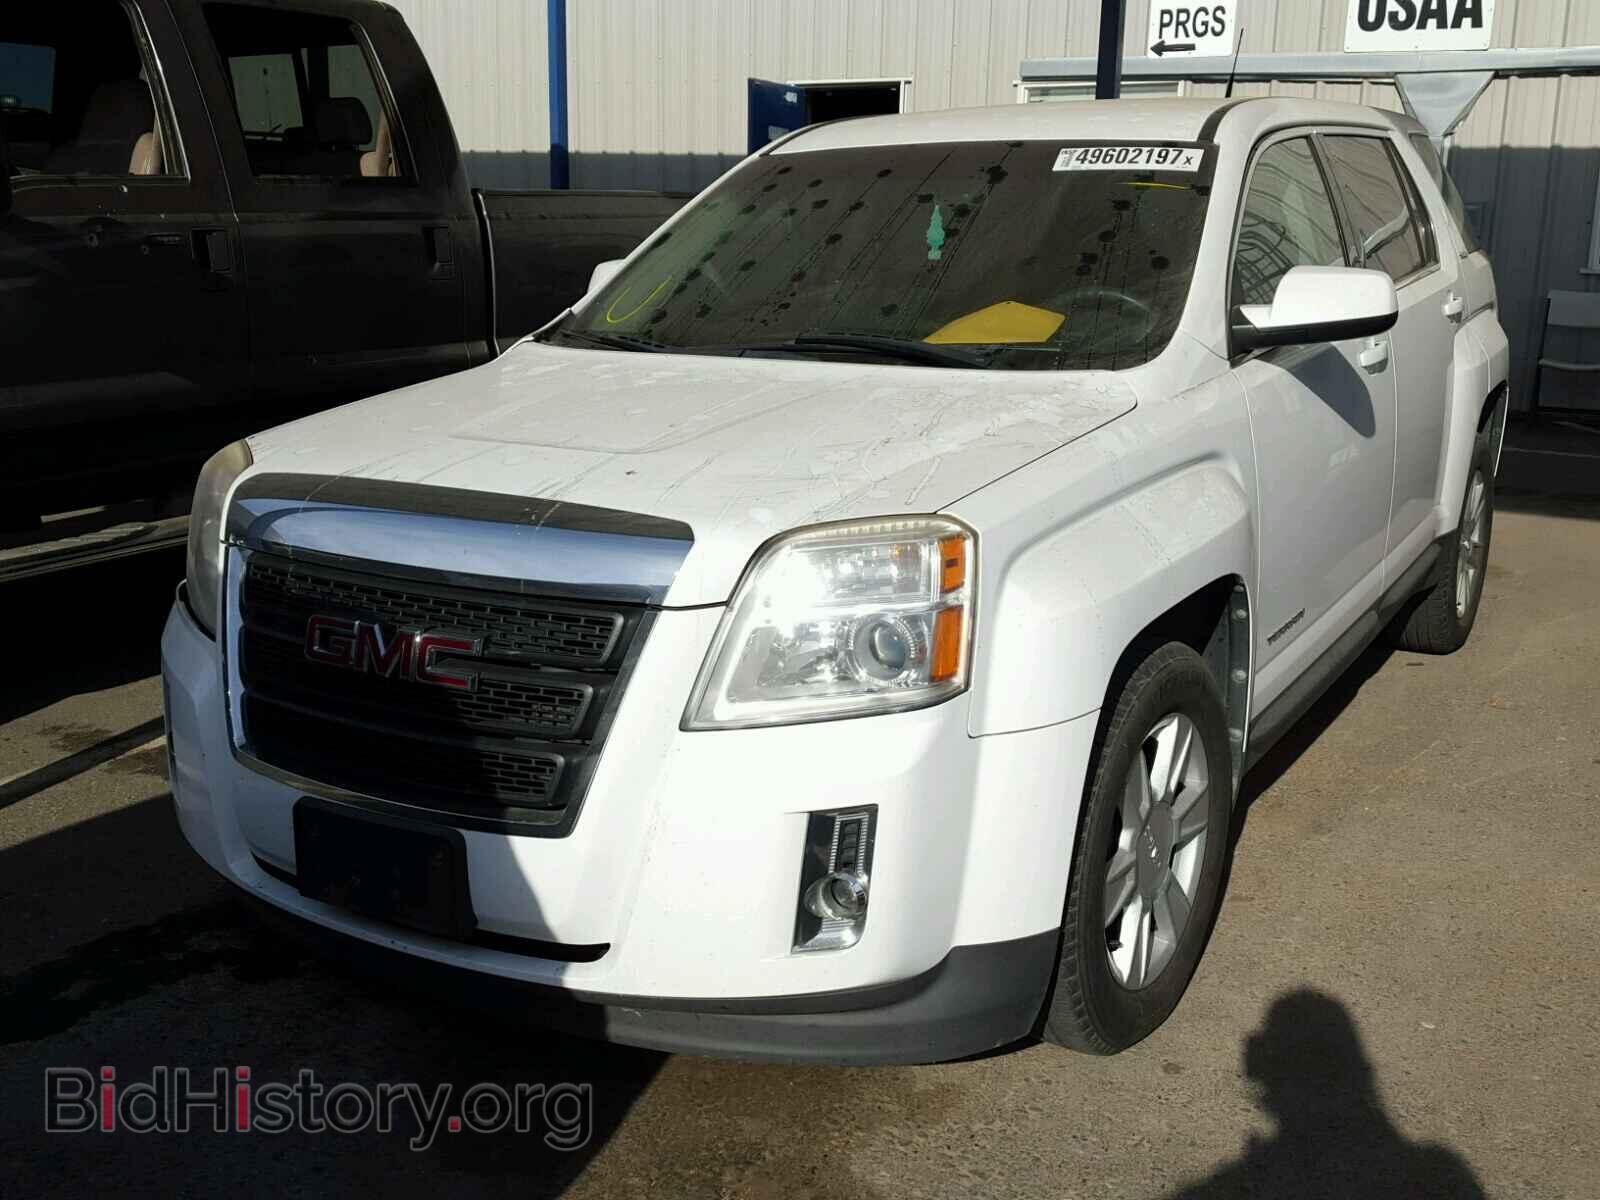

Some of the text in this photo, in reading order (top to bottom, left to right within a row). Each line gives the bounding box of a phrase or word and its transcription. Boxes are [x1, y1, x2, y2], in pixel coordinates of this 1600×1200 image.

[1158, 5, 1226, 39] PRGS
[1357, 0, 1483, 32] USAA
[304, 614, 482, 692] GMC
